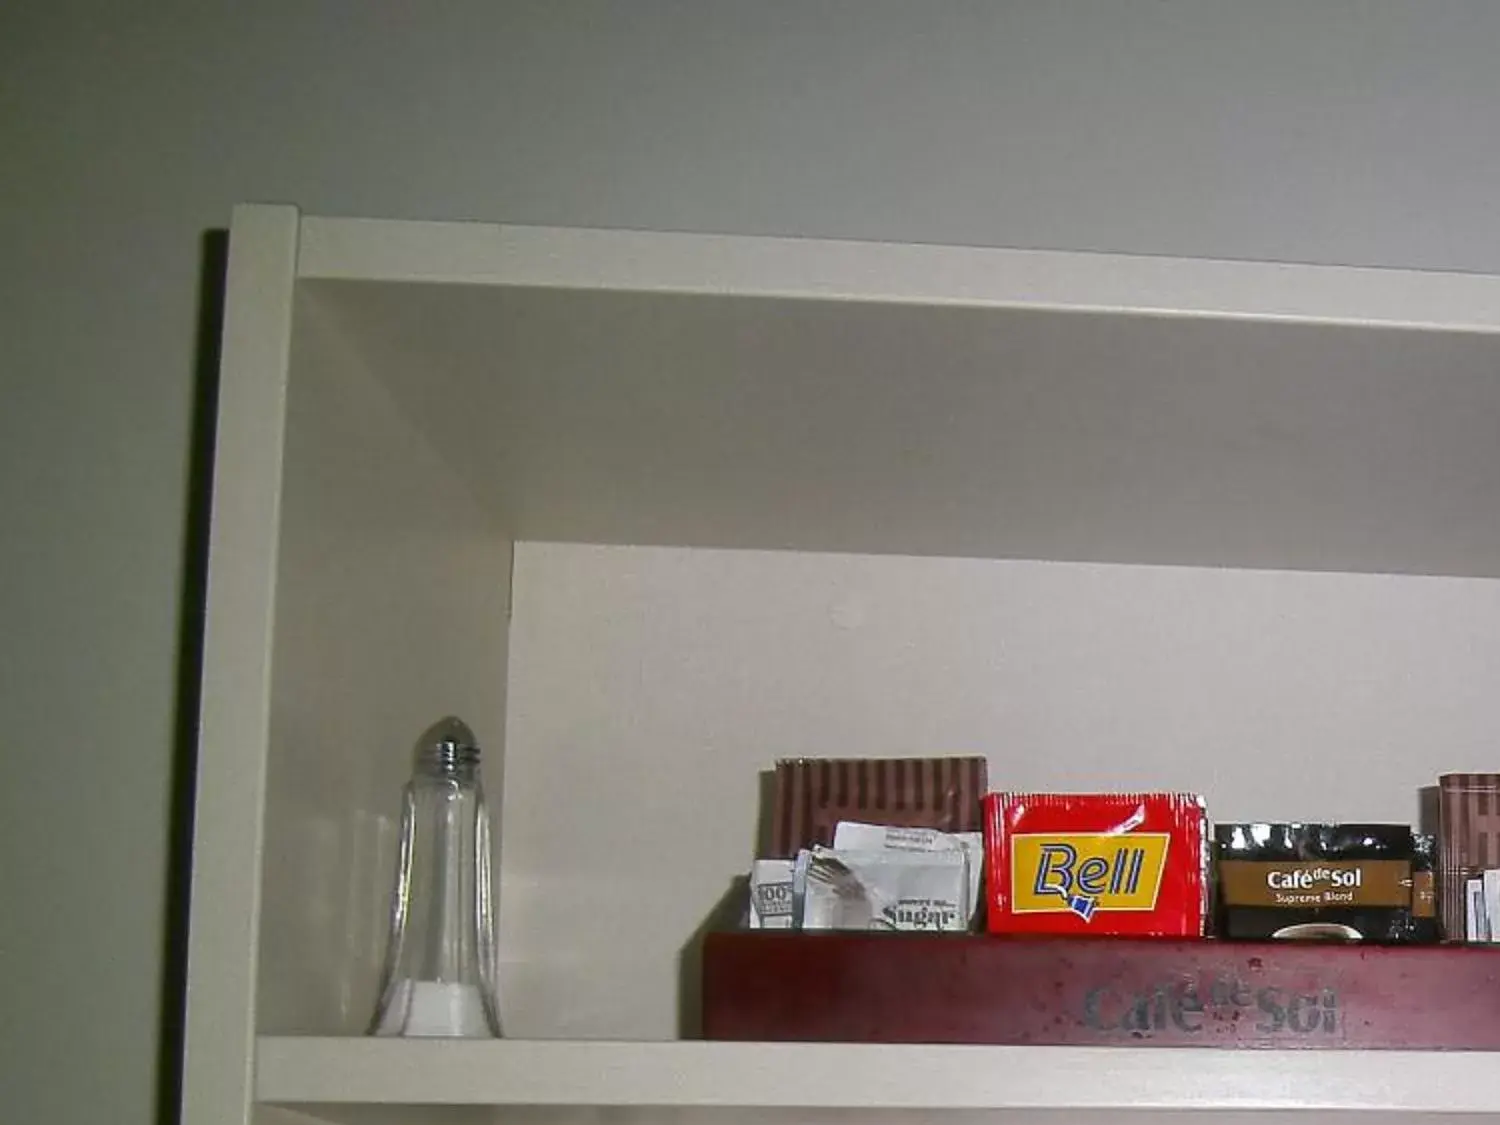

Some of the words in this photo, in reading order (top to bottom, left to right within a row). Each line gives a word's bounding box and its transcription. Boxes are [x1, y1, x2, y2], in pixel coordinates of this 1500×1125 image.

[1034, 842, 1144, 897] Bell
[1267, 870, 1313, 888] Café
[1313, 867, 1331, 881] de
[1331, 868, 1361, 887] Sol
